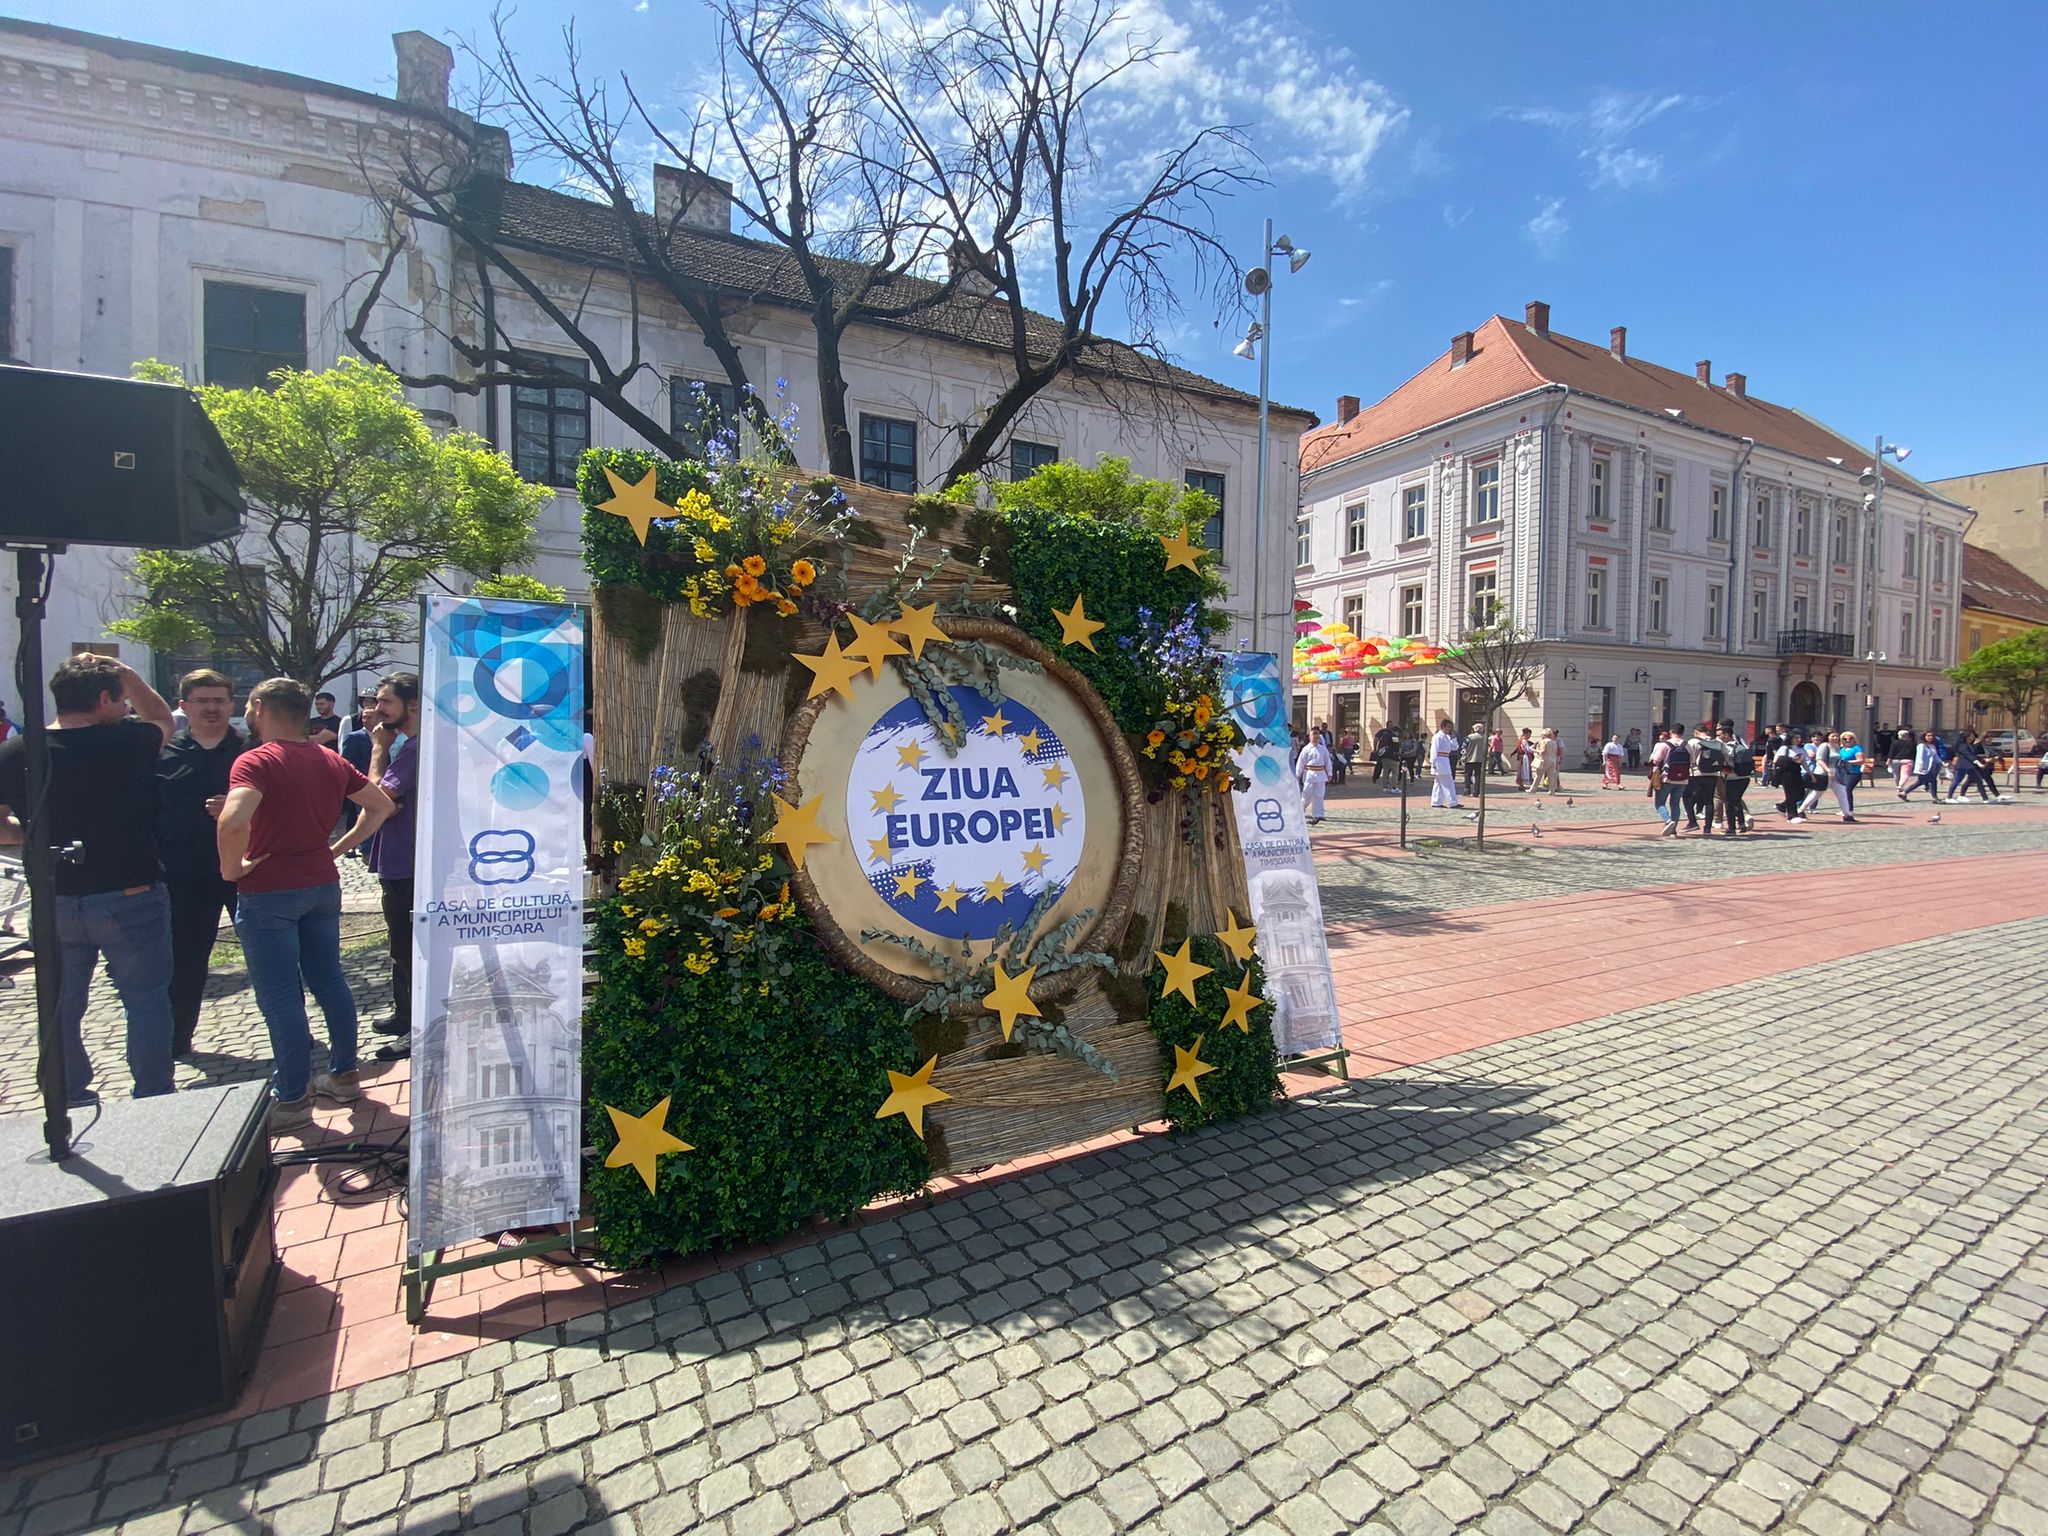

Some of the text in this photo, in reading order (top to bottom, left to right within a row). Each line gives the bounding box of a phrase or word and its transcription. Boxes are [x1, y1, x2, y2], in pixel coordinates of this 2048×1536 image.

[920, 766, 1021, 801] ZIUA
[886, 807, 1055, 849] EUROPEI
[426, 890, 572, 914] CASA DE CULTURĂ
[438, 907, 562, 927] A MUNICIPIULUI
